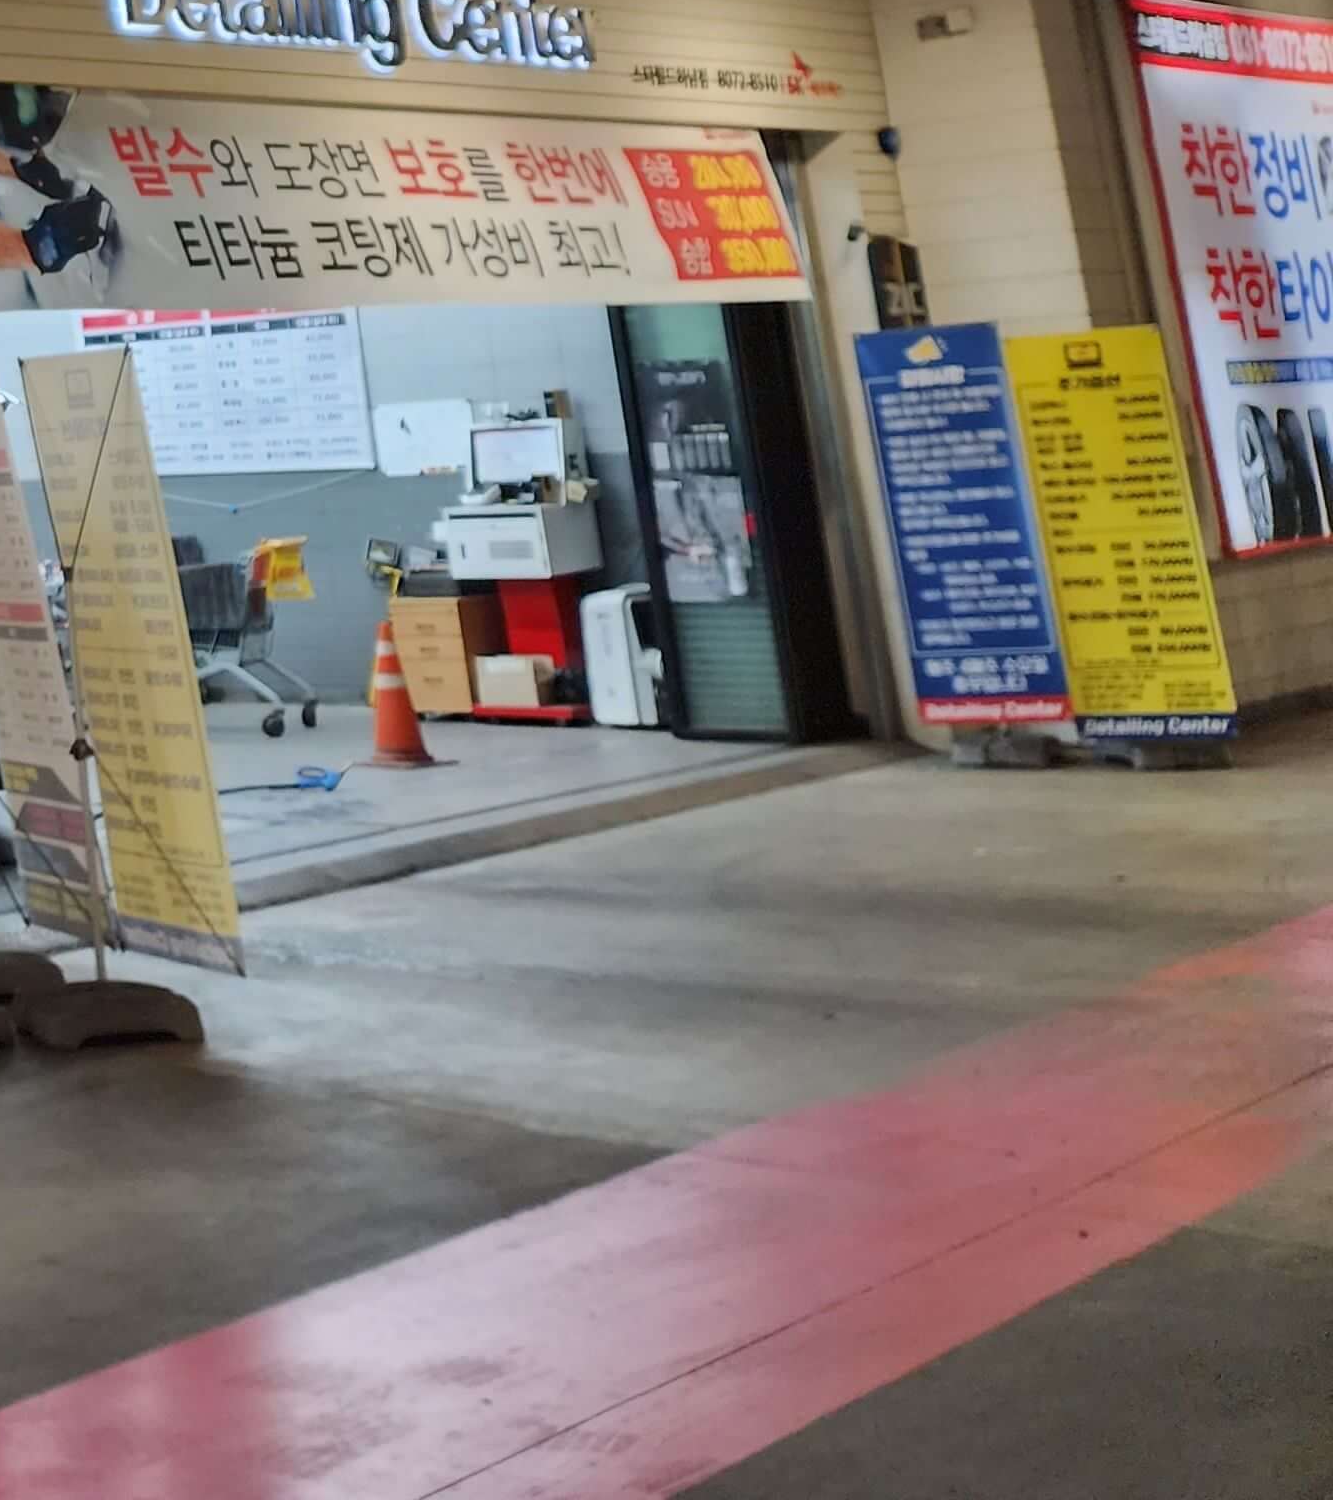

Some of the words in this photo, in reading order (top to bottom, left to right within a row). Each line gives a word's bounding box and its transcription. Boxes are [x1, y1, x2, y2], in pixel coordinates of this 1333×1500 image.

[108, 125, 260, 198] 발수와
[264, 137, 386, 199] 도장면
[383, 137, 509, 203] 보호를
[505, 141, 629, 207] 한번에
[1181, 123, 1321, 221] 착한정비
[173, 214, 305, 280] 티타늄
[310, 215, 435, 278] 코팅제
[430, 216, 545, 278] 가성비
[548, 218, 632, 277] 최고!
